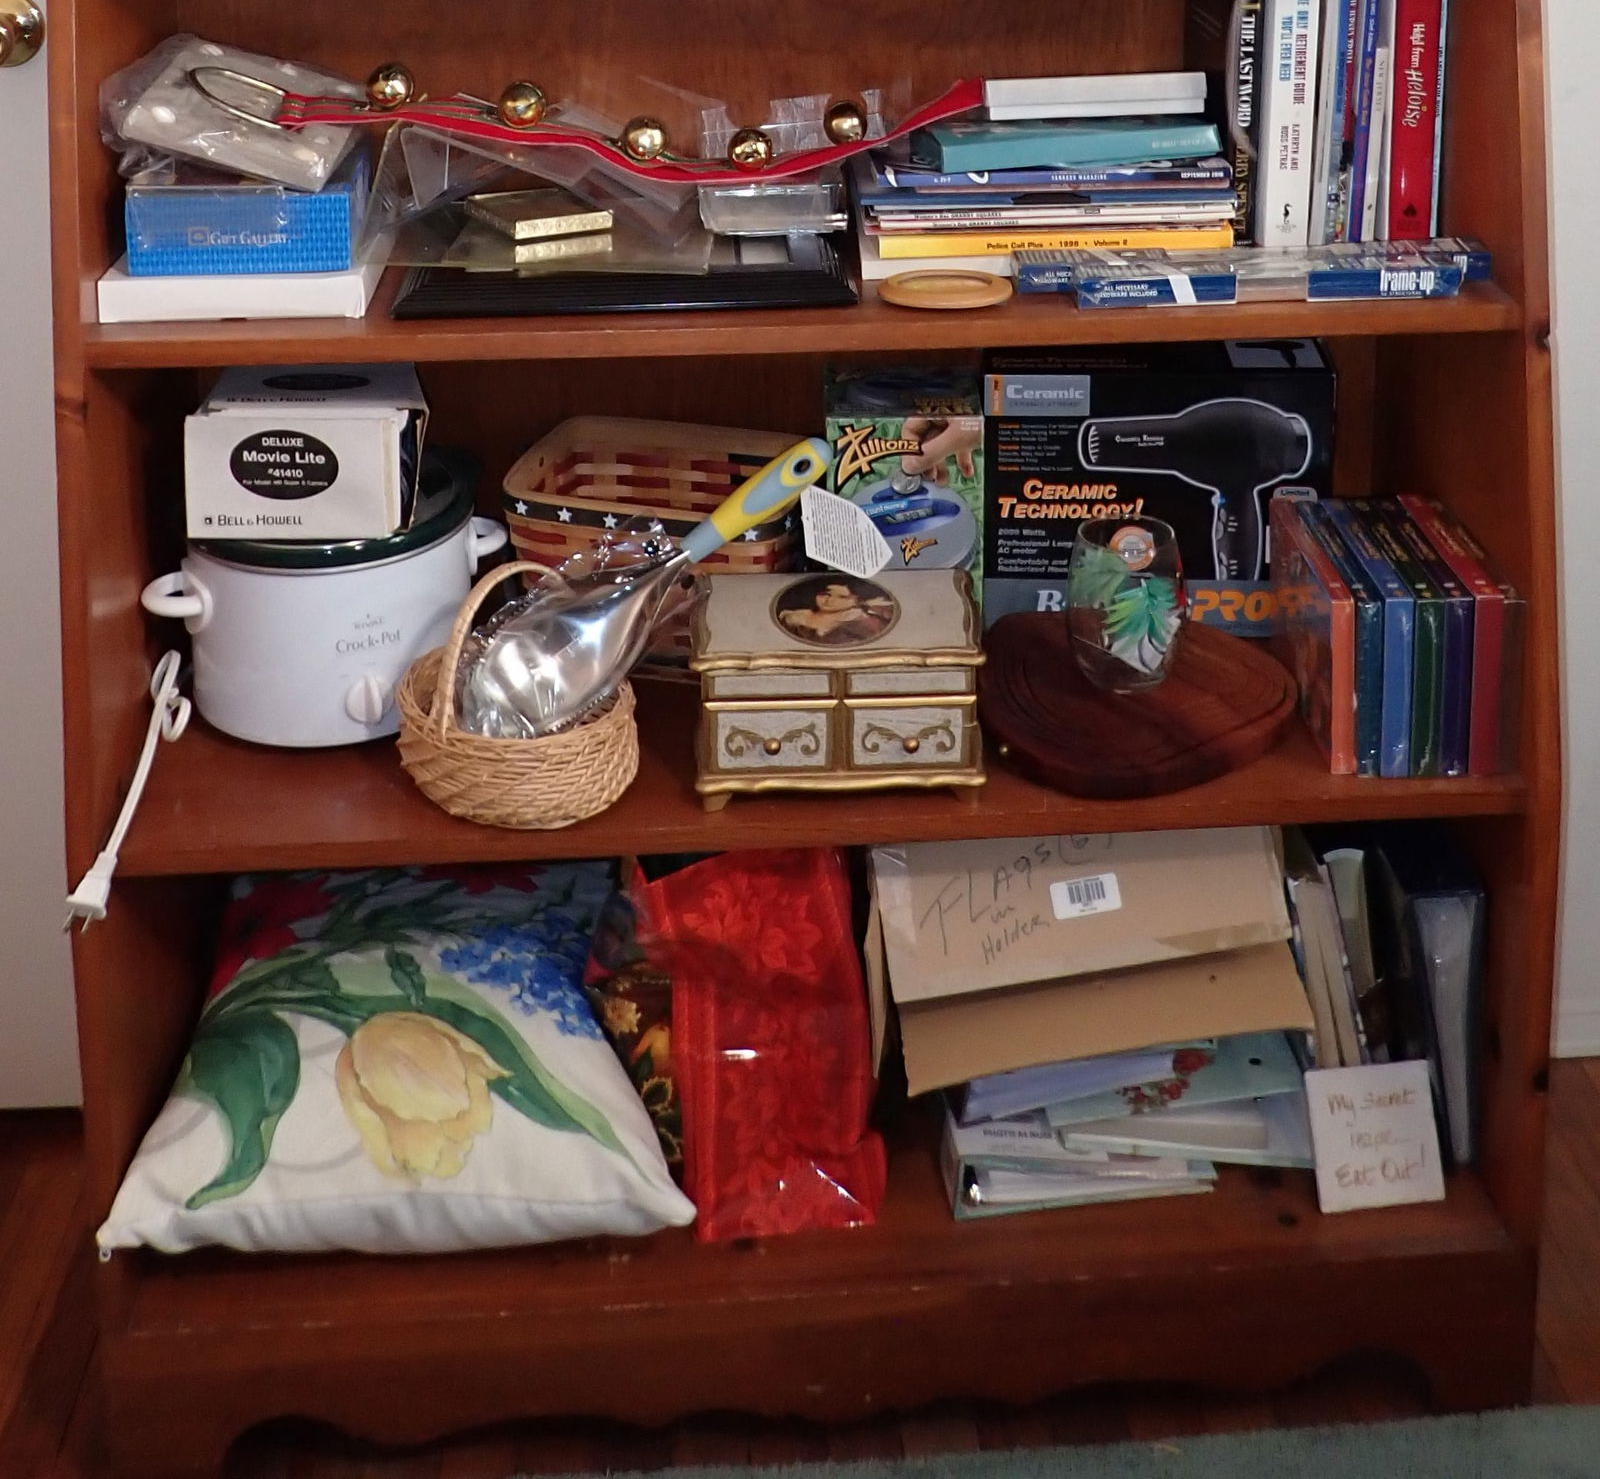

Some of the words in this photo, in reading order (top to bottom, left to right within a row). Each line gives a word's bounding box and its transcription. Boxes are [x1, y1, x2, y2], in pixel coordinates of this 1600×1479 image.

[1240, 13, 1256, 44] THE
[1296, 10, 1309, 30] ONLY
[1239, 46, 1255, 81] LAST
[1294, 33, 1308, 81] RETIREMENT
[1410, 47, 1425, 68] from
[1237, 81, 1253, 128] WORD
[1293, 83, 1306, 105] GUIDE
[1402, 69, 1427, 127] Heloise
[1279, 144, 1289, 171] PETRAS
[1291, 156, 1299, 171] AND
[1011, 241, 1026, 249] Call
[1027, 241, 1043, 249] Plus
[1093, 239, 1120, 247] Volume
[1116, 283, 1149, 292] NECESSARY
[1129, 289, 1158, 298] INCLUDED
[1005, 384, 1085, 399] Ceramic
[261, 437, 304, 447] DELUXE
[242, 450, 291, 463] Movie
[295, 451, 326, 464] Lite
[1023, 478, 1118, 500] CERAMIC
[998, 496, 1144, 520] TECHNOLOGY!
[217, 514, 244, 526] BELL
[256, 514, 303, 526] HOWELL
[1022, 528, 1046, 537] Watts
[998, 539, 1050, 548] Professional
[1191, 589, 1272, 622] PRO
[1327, 1093, 1356, 1119] My
